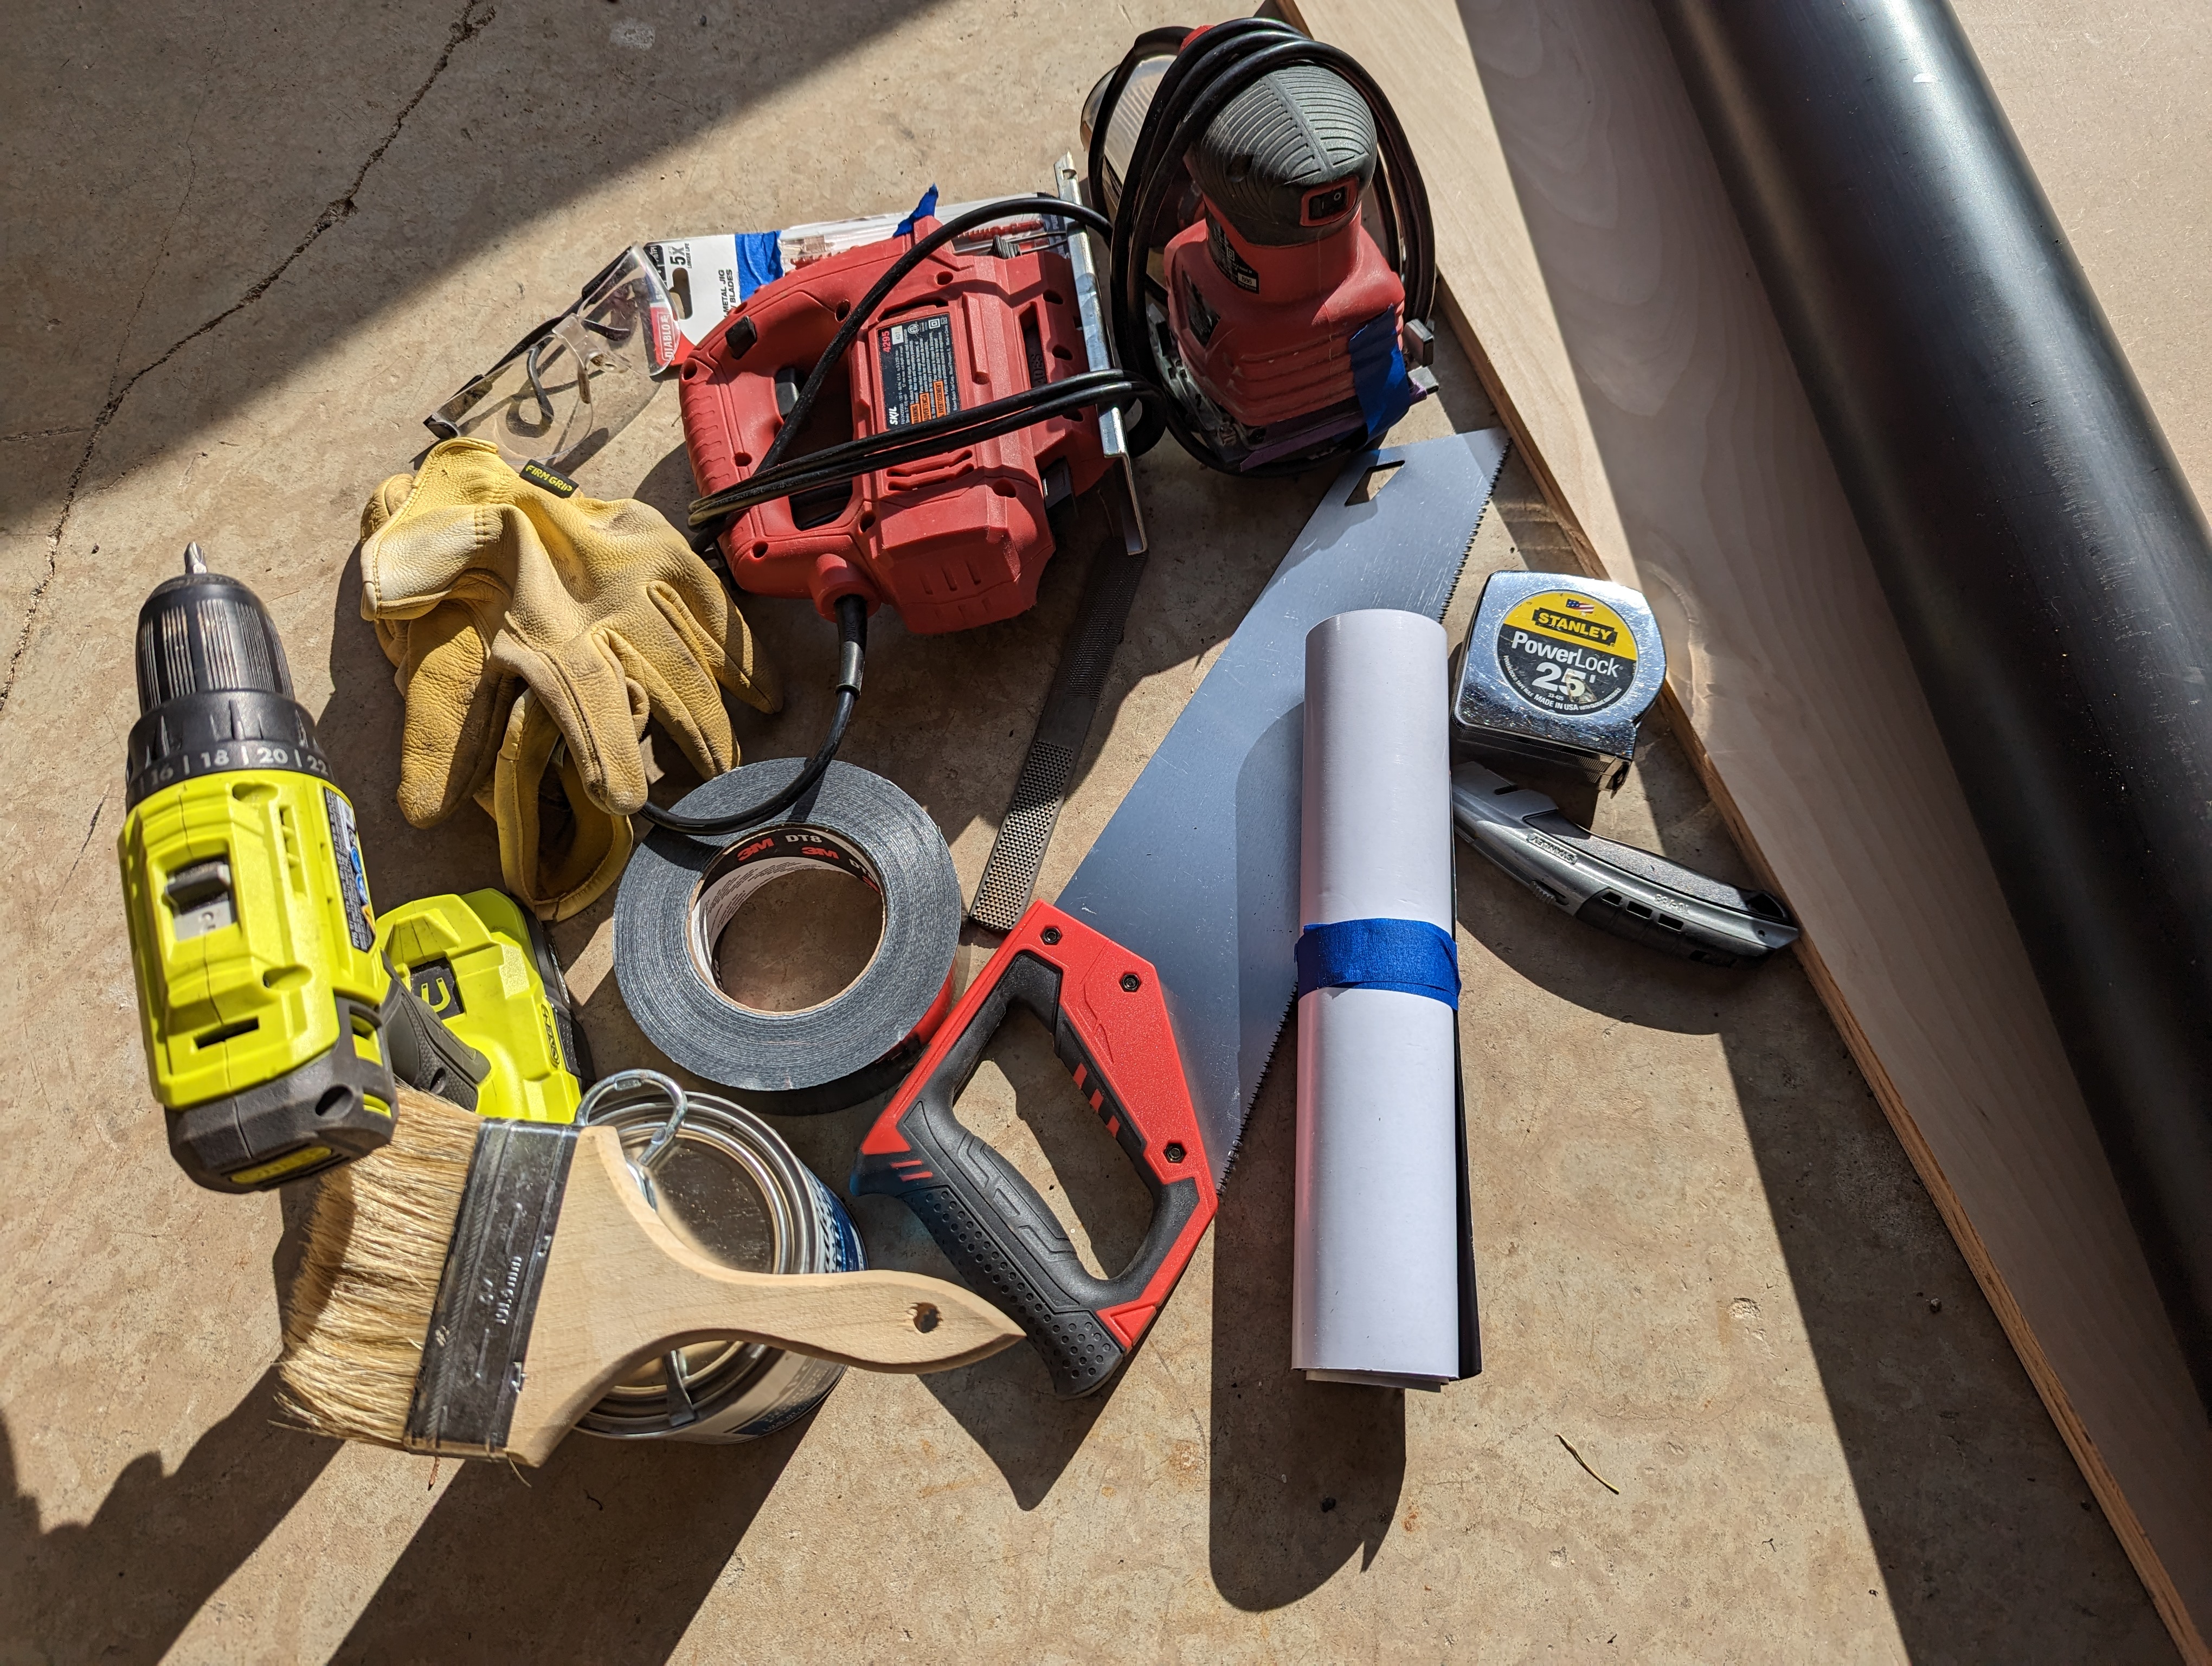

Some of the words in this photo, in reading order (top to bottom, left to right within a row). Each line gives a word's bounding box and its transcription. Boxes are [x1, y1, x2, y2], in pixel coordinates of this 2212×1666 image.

[670, 247, 686, 265] 5X
[726, 270, 736, 303] BLADES
[661, 324, 674, 360] DIABLO
[882, 330, 891, 353] 4295
[889, 406, 899, 425] SKIL
[526, 465, 550, 482] FIRM
[548, 477, 573, 492] GRIP
[1538, 612, 1612, 640] STANLEY
[1511, 631, 1619, 678] PowerLock
[1515, 680, 1526, 690] TAPE
[1523, 688, 1534, 697] RULE
[1533, 694, 1554, 707] MADE
[1590, 699, 1604, 709] GLOBAL
[1603, 687, 1623, 703] MATERIALS
[1548, 693, 1564, 701] 33-425
[150, 766, 173, 785] 16
[201, 749, 229, 768] 18
[256, 746, 289, 765] 20
[307, 755, 329, 776] 22
[737, 837, 774, 861] 3M
[785, 834, 822, 843] DT8
[1528, 835, 1576, 862] STANLEY
[801, 846, 839, 860] 3M
